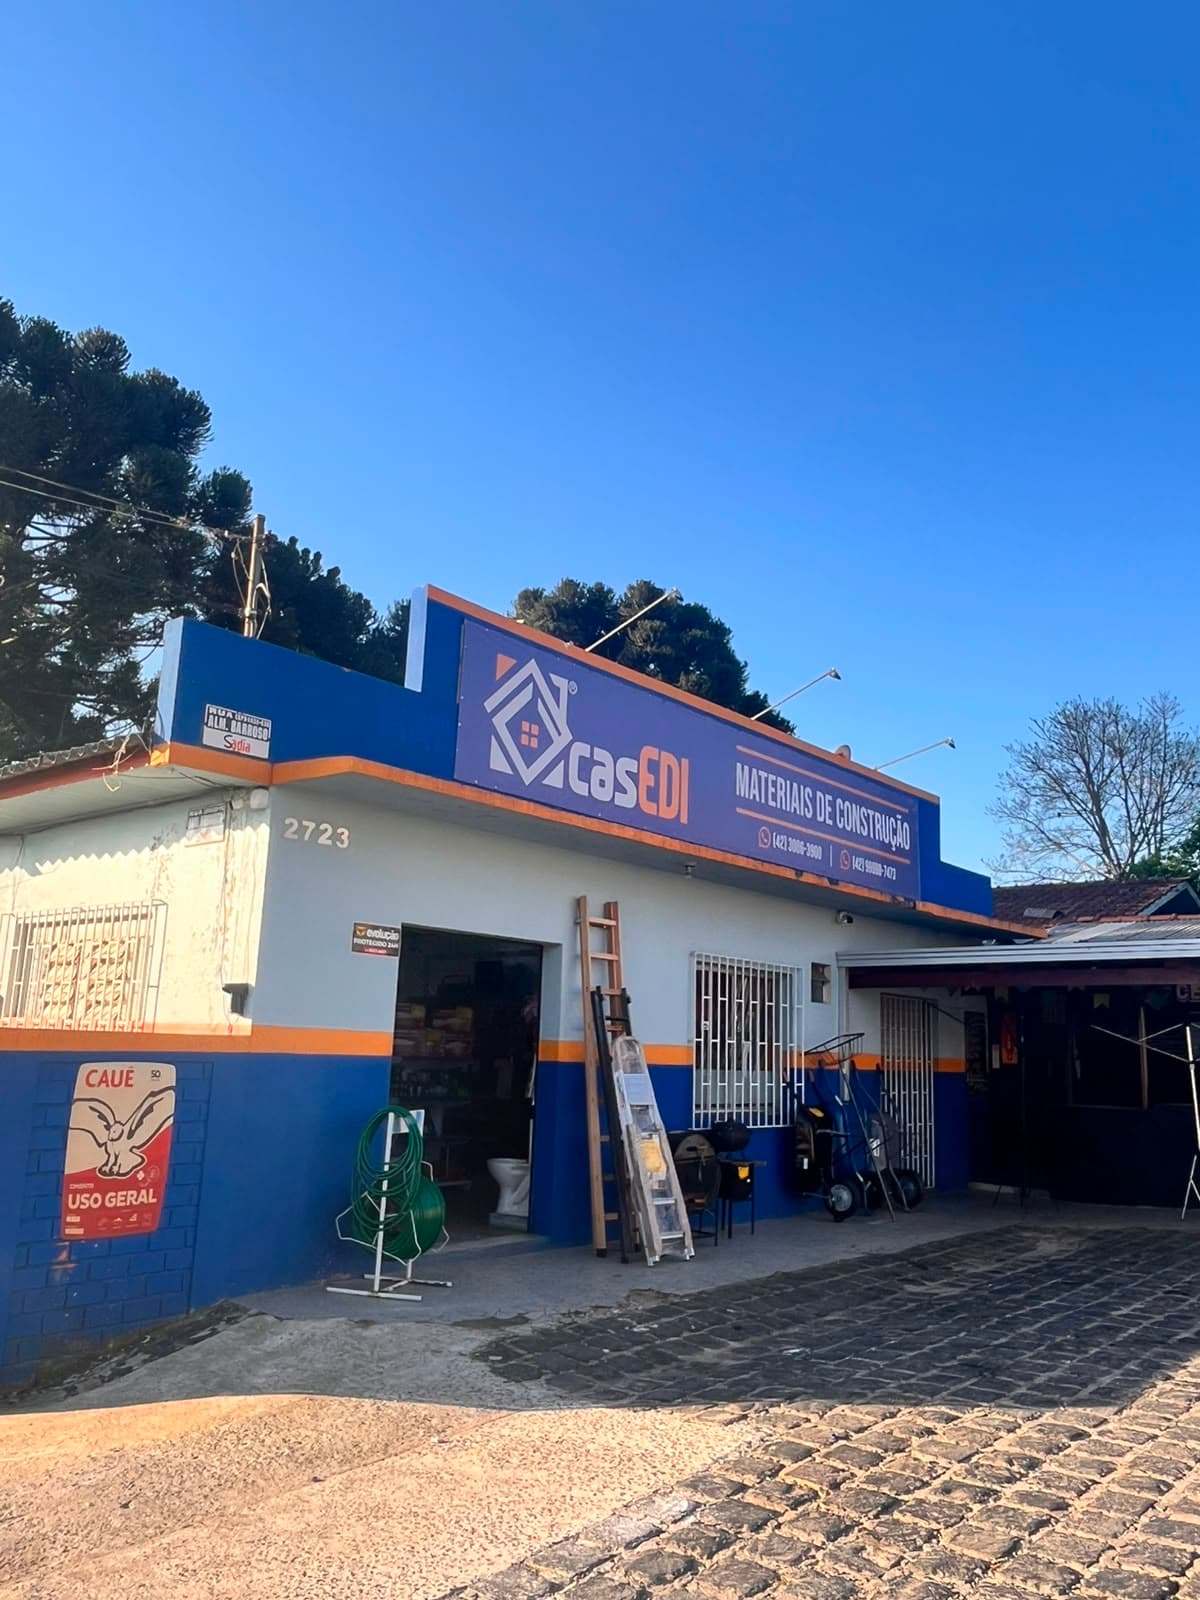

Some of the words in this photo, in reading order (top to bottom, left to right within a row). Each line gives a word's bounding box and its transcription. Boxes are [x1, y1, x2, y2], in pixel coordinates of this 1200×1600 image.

[207, 714, 230, 731] ALM.
[230, 719, 268, 741] BARROSO
[735, 762, 813, 819] MATERIAIS
[815, 790, 833, 826] DE
[835, 797, 911, 851] CONSTRUÇÃO
[283, 817, 350, 849] 2723
[772, 831, 788, 851] (42)
[67, 1192, 102, 1210] USO
[105, 1188, 157, 1208] GERAL
